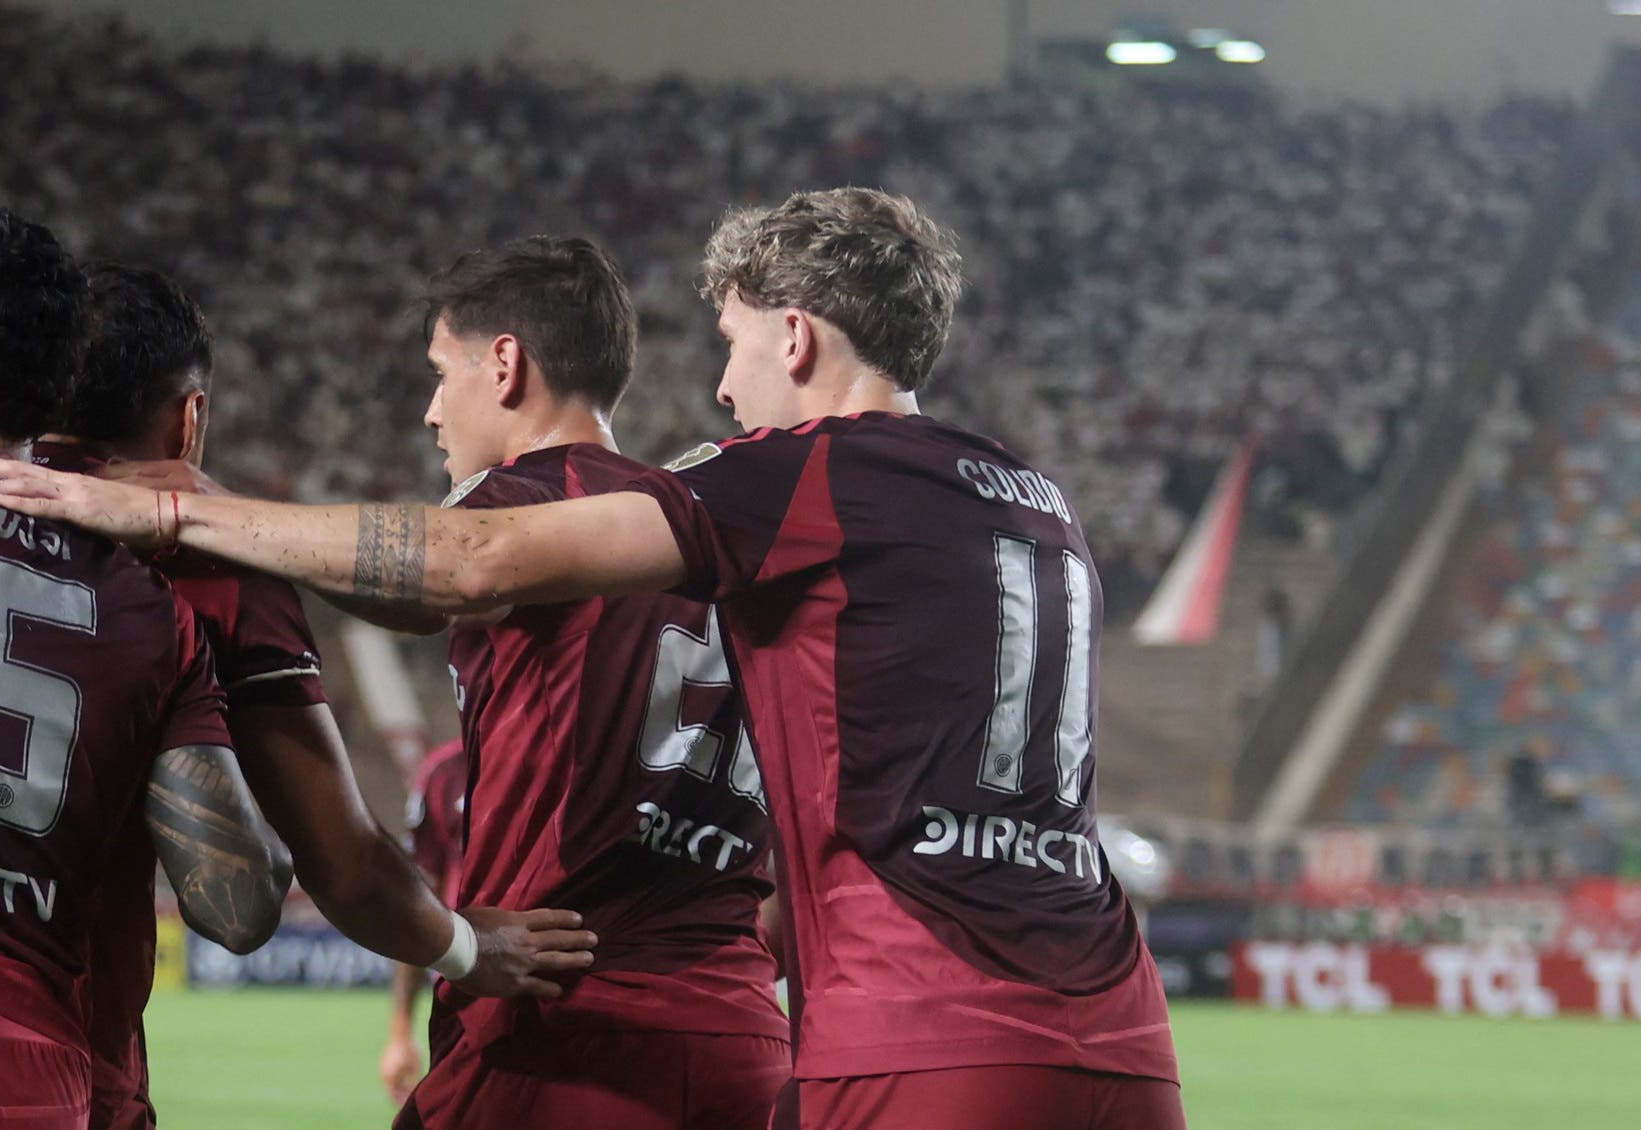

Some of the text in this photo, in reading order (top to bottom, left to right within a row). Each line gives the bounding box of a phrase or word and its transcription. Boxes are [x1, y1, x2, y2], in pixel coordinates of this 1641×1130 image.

[976, 531, 1093, 809] 11
[912, 805, 1102, 885] DIRECTV
[1247, 942, 1391, 1010] TCL
[1422, 945, 1559, 1017] TCL
